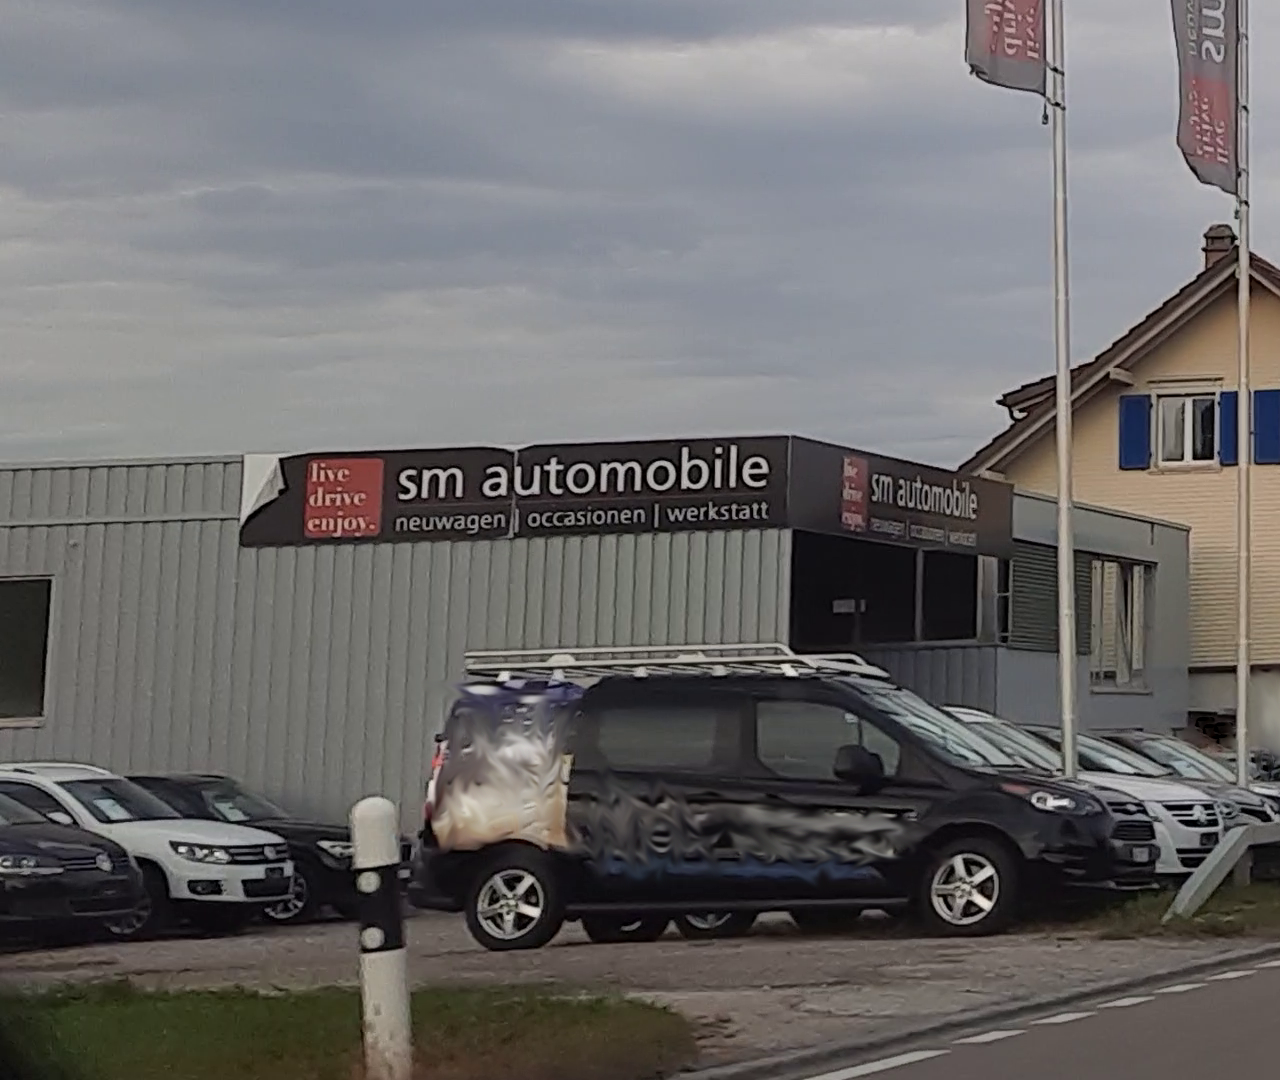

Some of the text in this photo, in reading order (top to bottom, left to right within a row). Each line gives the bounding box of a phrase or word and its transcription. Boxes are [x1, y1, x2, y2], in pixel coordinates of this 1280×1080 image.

[310, 463, 350, 482] live
[398, 445, 770, 500] sm automobile
[308, 487, 367, 508] drive
[871, 473, 978, 520] sm automobile
[307, 511, 376, 537] enjoy.
[394, 501, 769, 535] neuwagen occasionen werkstatt
